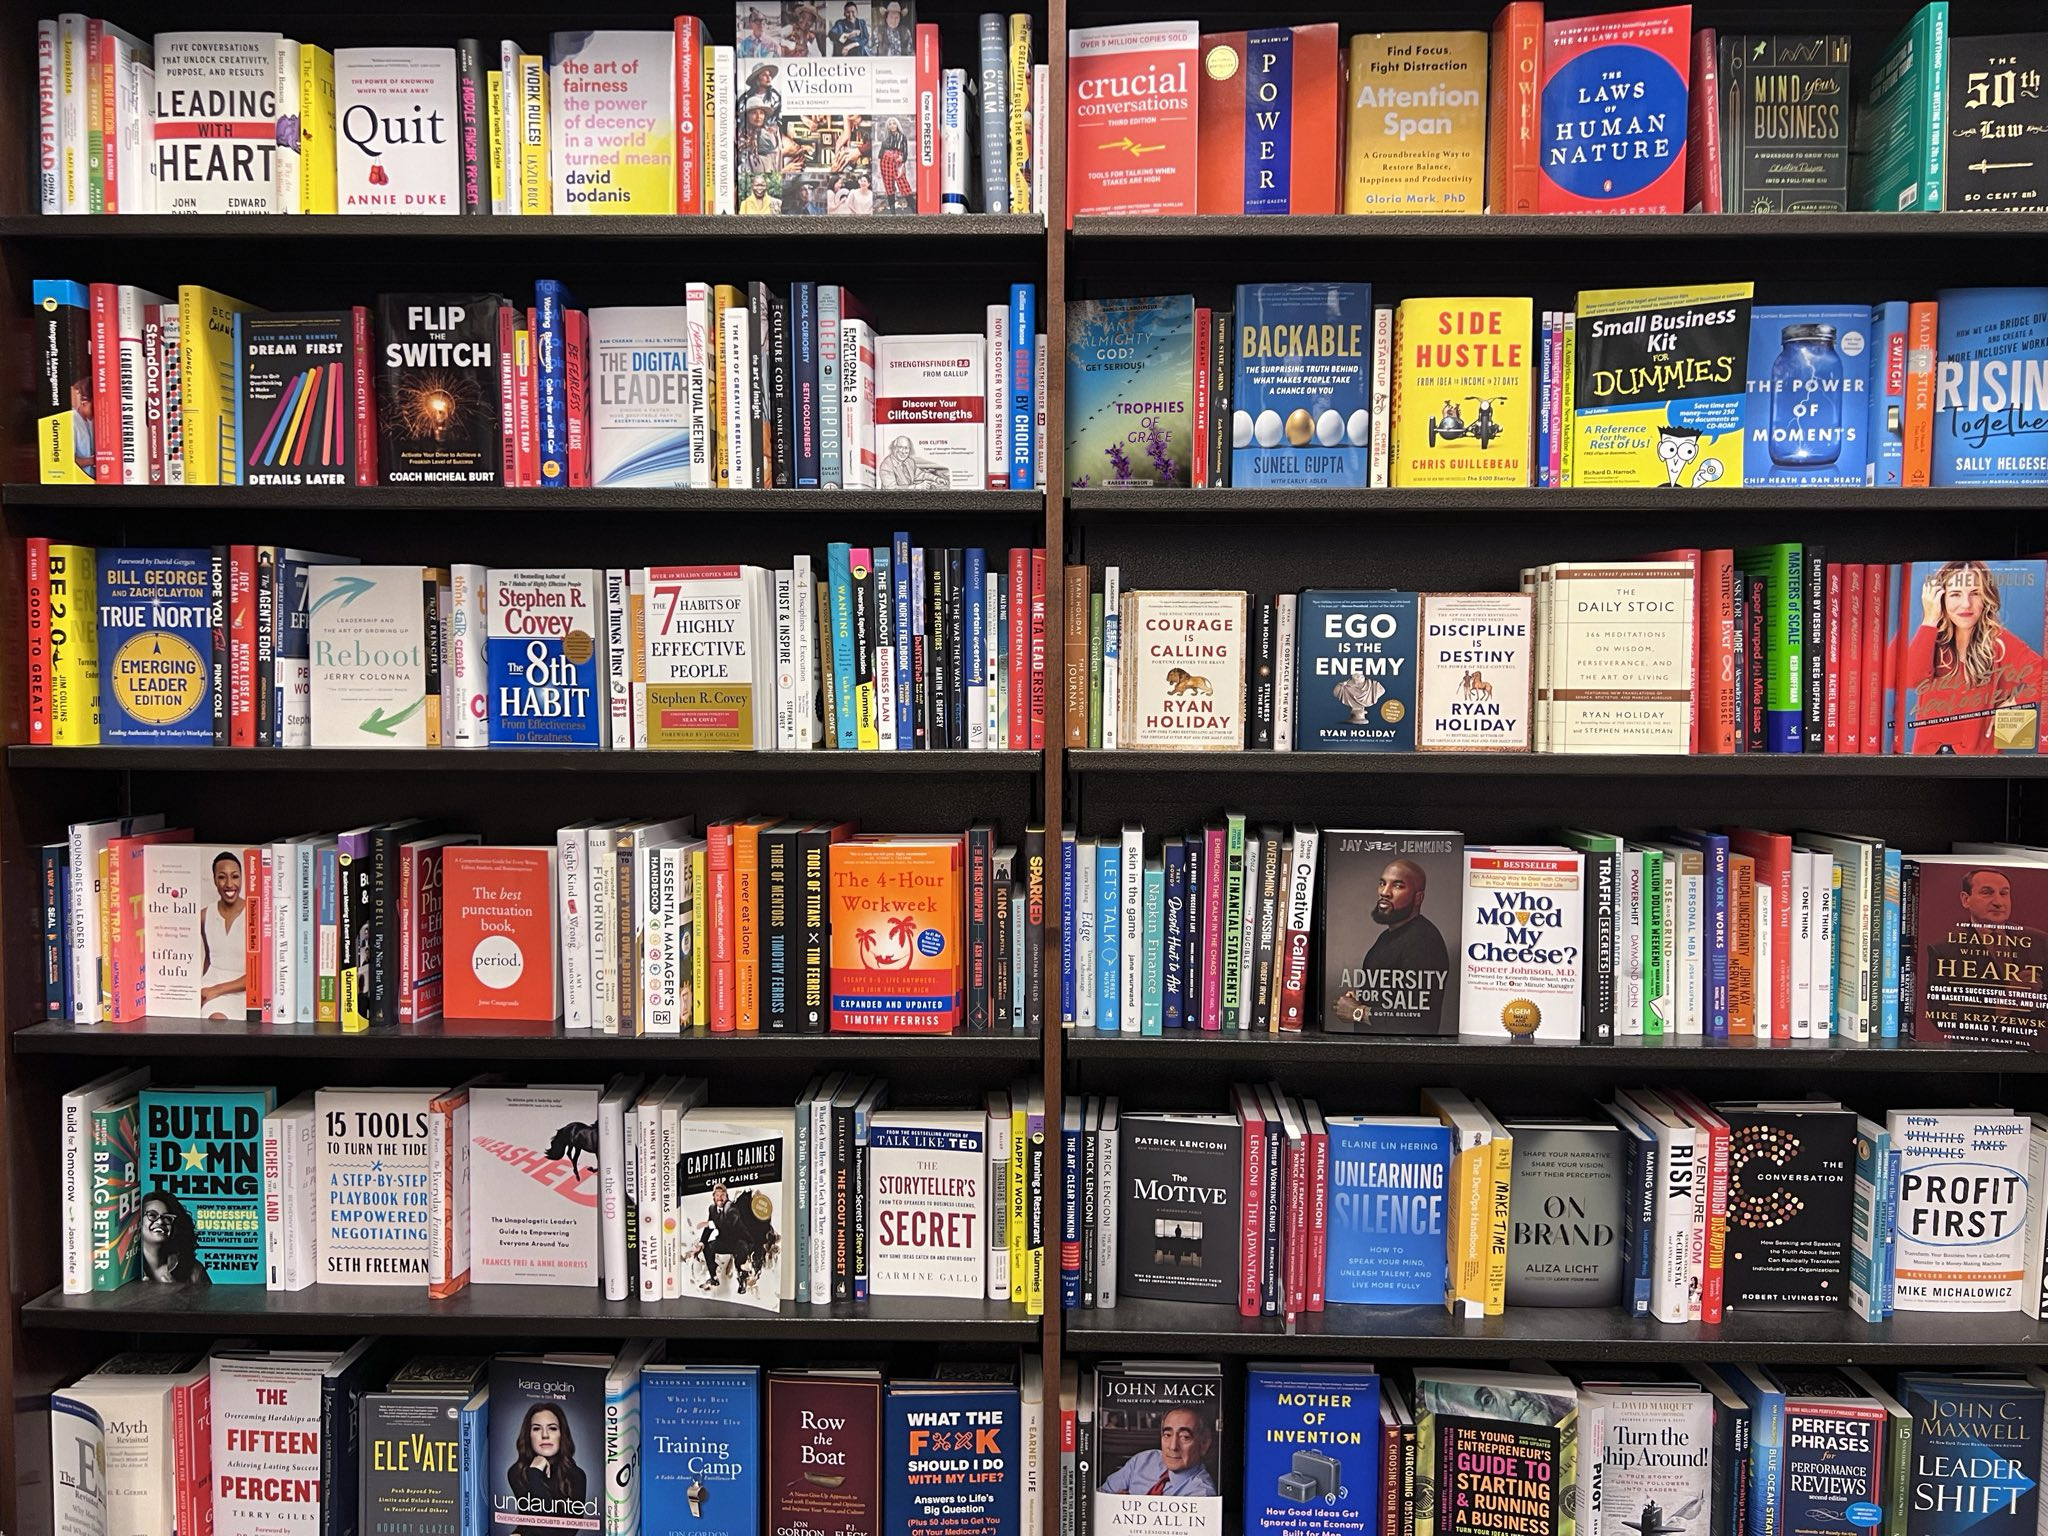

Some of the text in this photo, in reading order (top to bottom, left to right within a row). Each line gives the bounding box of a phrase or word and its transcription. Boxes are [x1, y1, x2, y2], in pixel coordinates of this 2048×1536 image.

[787, 63, 865, 78] Collective
[1371, 60, 1467, 72] Fight Distraction
[563, 78, 627, 93] fairness
[788, 79, 853, 94] Wisdom
[983, 70, 997, 114] CALM
[1078, 62, 1188, 100] crucial
[1755, 74, 1840, 103] MIND your
[1965, 69, 2040, 110] 50th
[40, 30, 55, 170] LET THEM LEAD
[157, 91, 275, 117] LEADING
[1357, 83, 1479, 107] Attention
[1579, 82, 1645, 104] LAWS
[527, 66, 541, 146] WORK RULES!
[1078, 97, 1187, 116] conversations
[198, 124, 233, 137] WITH
[343, 105, 446, 157] Quit
[1130, 116, 1156, 126] EDITION
[1557, 114, 1666, 141] HUMAN
[1755, 105, 1839, 139] BUSINESS
[160, 144, 275, 182] HEART
[1550, 139, 1669, 166] NATURE
[347, 194, 446, 205] ANNIE DUKE
[566, 189, 630, 203] bodanis
[408, 307, 465, 331] FLIP
[1439, 312, 1502, 335] SIDE
[1592, 308, 1736, 338] Small Business
[249, 344, 342, 355] DREAM FIRST
[1243, 325, 1362, 358] BACKABLE
[387, 343, 491, 367] SWITCH
[632, 352, 687, 372] DIGITAL
[890, 361, 955, 369] STRENGTHSFINDER
[1416, 345, 1521, 367] HUSTLE
[1891, 337, 1902, 388] SWITCH
[145, 324, 160, 420] StandOut 2.0
[1593, 358, 1733, 396] DUMMIES
[1746, 379, 1864, 392] THE POWER
[690, 367, 704, 464] VIRTUAL MEETINGS
[888, 409, 973, 421] CliftonStrengths
[1116, 402, 1184, 414] TROPHIES
[821, 383, 837, 459] PURPOSE
[51, 419, 60, 463] dummies
[1014, 414, 1029, 464] CHOICE
[1752, 428, 1857, 441] MOMENTS
[1254, 456, 1344, 473] SUNEEL GUPTA
[389, 471, 495, 482] COACH MICHEAL BURT
[108, 570, 207, 585] BILL GEORGE
[1578, 602, 1674, 612] DAILY STOIC
[505, 609, 572, 636] Covey
[1146, 620, 1233, 631] COURAGE
[1325, 614, 1397, 638] EGO
[1430, 625, 1525, 636] DISCIPLINE
[780, 625, 790, 664] INSPIRE
[1753, 616, 1763, 660] Pumped
[315, 639, 421, 667] Reboot
[1032, 602, 1044, 715] META LEADERSHIP
[1440, 652, 1514, 663] DESTINY
[121, 660, 196, 673] EMERGING
[1316, 658, 1404, 675] ENEMY
[500, 688, 589, 718] HABIT
[1164, 700, 1212, 712] RYAN
[1147, 716, 1231, 728] HOLIDAY
[651, 856, 659, 911] HANDBOOK
[1030, 856, 1043, 926] SPARKED
[1599, 858, 1611, 916] TRAFFIC
[462, 904, 533, 918] punctuation
[807, 894, 820, 928] TITANS
[843, 897, 937, 912] Workweek
[1286, 864, 1310, 989] Creative Calling
[1227, 876, 1239, 1004] FINANCIAL STATEMENTS
[152, 950, 194, 963] tiffany
[476, 954, 520, 969] period.
[1468, 943, 1577, 963] Cheese?
[1339, 968, 1448, 988] ADVERSITY
[1468, 965, 1552, 976] Spencer Johnson,
[841, 1001, 882, 1009] EXPANDED
[906, 1001, 942, 1009] UPDATED
[149, 1105, 258, 1139] BUILD
[1135, 1137, 1227, 1150] PATRICK LENCIONI
[67, 1148, 77, 1202] Tomorrow
[1335, 1160, 1443, 1189] UNLEARNING
[1669, 1145, 1693, 1199] RISK
[1757, 1174, 1843, 1182] CONVERSATION
[879, 1177, 976, 1198] STORYTELLER'S
[1134, 1178, 1226, 1205] MOTIVE
[1903, 1176, 2019, 1203] PROFIT
[197, 1211, 258, 1220] SUCCESSFUL
[1335, 1193, 1441, 1235] SILENCE
[1914, 1211, 2007, 1237] FIRST
[628, 1204, 637, 1249] TRUTHS
[880, 1210, 976, 1248] SECRET
[1514, 1222, 1613, 1246] BRAND
[877, 1272, 978, 1283] CARMINE GALLO
[1782, 1294, 1838, 1302] LIVINGSTON
[1897, 1286, 2012, 1298] MIKE MICHALOWICZ
[519, 1379, 575, 1393] kara goldin
[1107, 1382, 1215, 1397] JOHN MACK
[1278, 1394, 1351, 1408] MOTHER
[1267, 1431, 1361, 1444] INVENTION
[1792, 1418, 1870, 1436] PERFECT
[1920, 1419, 2030, 1441] MAXWELL
[227, 1429, 318, 1454] FIFTEEN
[654, 1437, 729, 1459] Training
[1457, 1441, 1551, 1461] ENTREPRENEUR'S
[688, 1458, 742, 1479] Camp
[1638, 1448, 1708, 1467] Around!
[1457, 1473, 1550, 1500] STARTING
[1791, 1476, 1866, 1496] REVIEWS
[494, 1493, 600, 1516] undaunted.
[942, 1504, 984, 1515] Question
[1914, 1483, 2026, 1515] SHIFT
